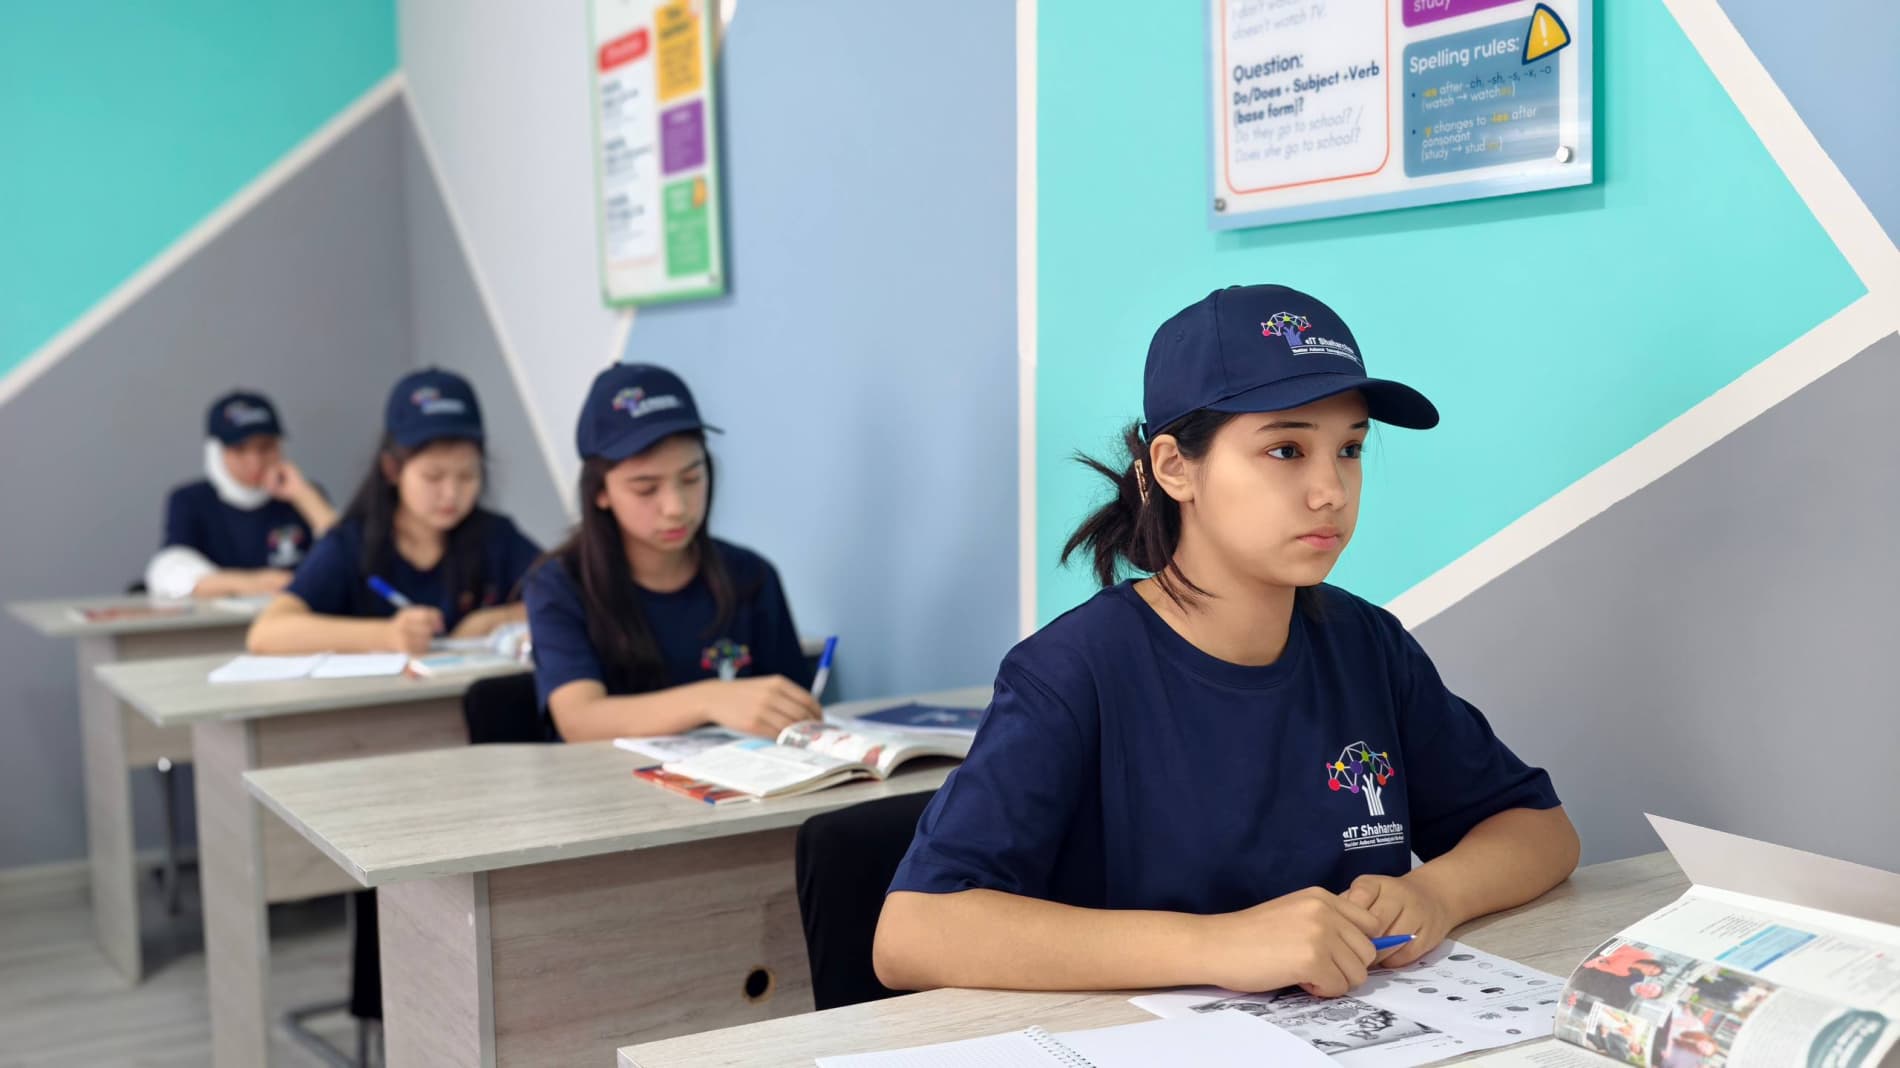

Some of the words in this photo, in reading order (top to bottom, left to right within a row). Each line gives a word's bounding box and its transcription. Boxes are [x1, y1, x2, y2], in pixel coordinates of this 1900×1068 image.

[1273, 9, 1307, 29] watch
[1410, 48, 1469, 74] Spelling
[1473, 37, 1519, 59] rules:
[1233, 54, 1304, 84] Question:
[1233, 86, 1282, 105] Do/Does
[1293, 71, 1340, 93] Subject
[1440, 80, 1463, 96] after
[1422, 96, 1455, 113] (watch
[1233, 109, 1264, 128] (base
[1434, 117, 1474, 135] changes
[1476, 115, 1487, 126] to
[1512, 104, 1537, 120] after
[1252, 124, 1274, 141] they
[1278, 124, 1291, 140] go
[1295, 120, 1306, 132] to
[1284, 143, 1299, 160] go
[1303, 137, 1315, 151] to
[1317, 127, 1361, 150] school?
[1422, 146, 1449, 163] (study
